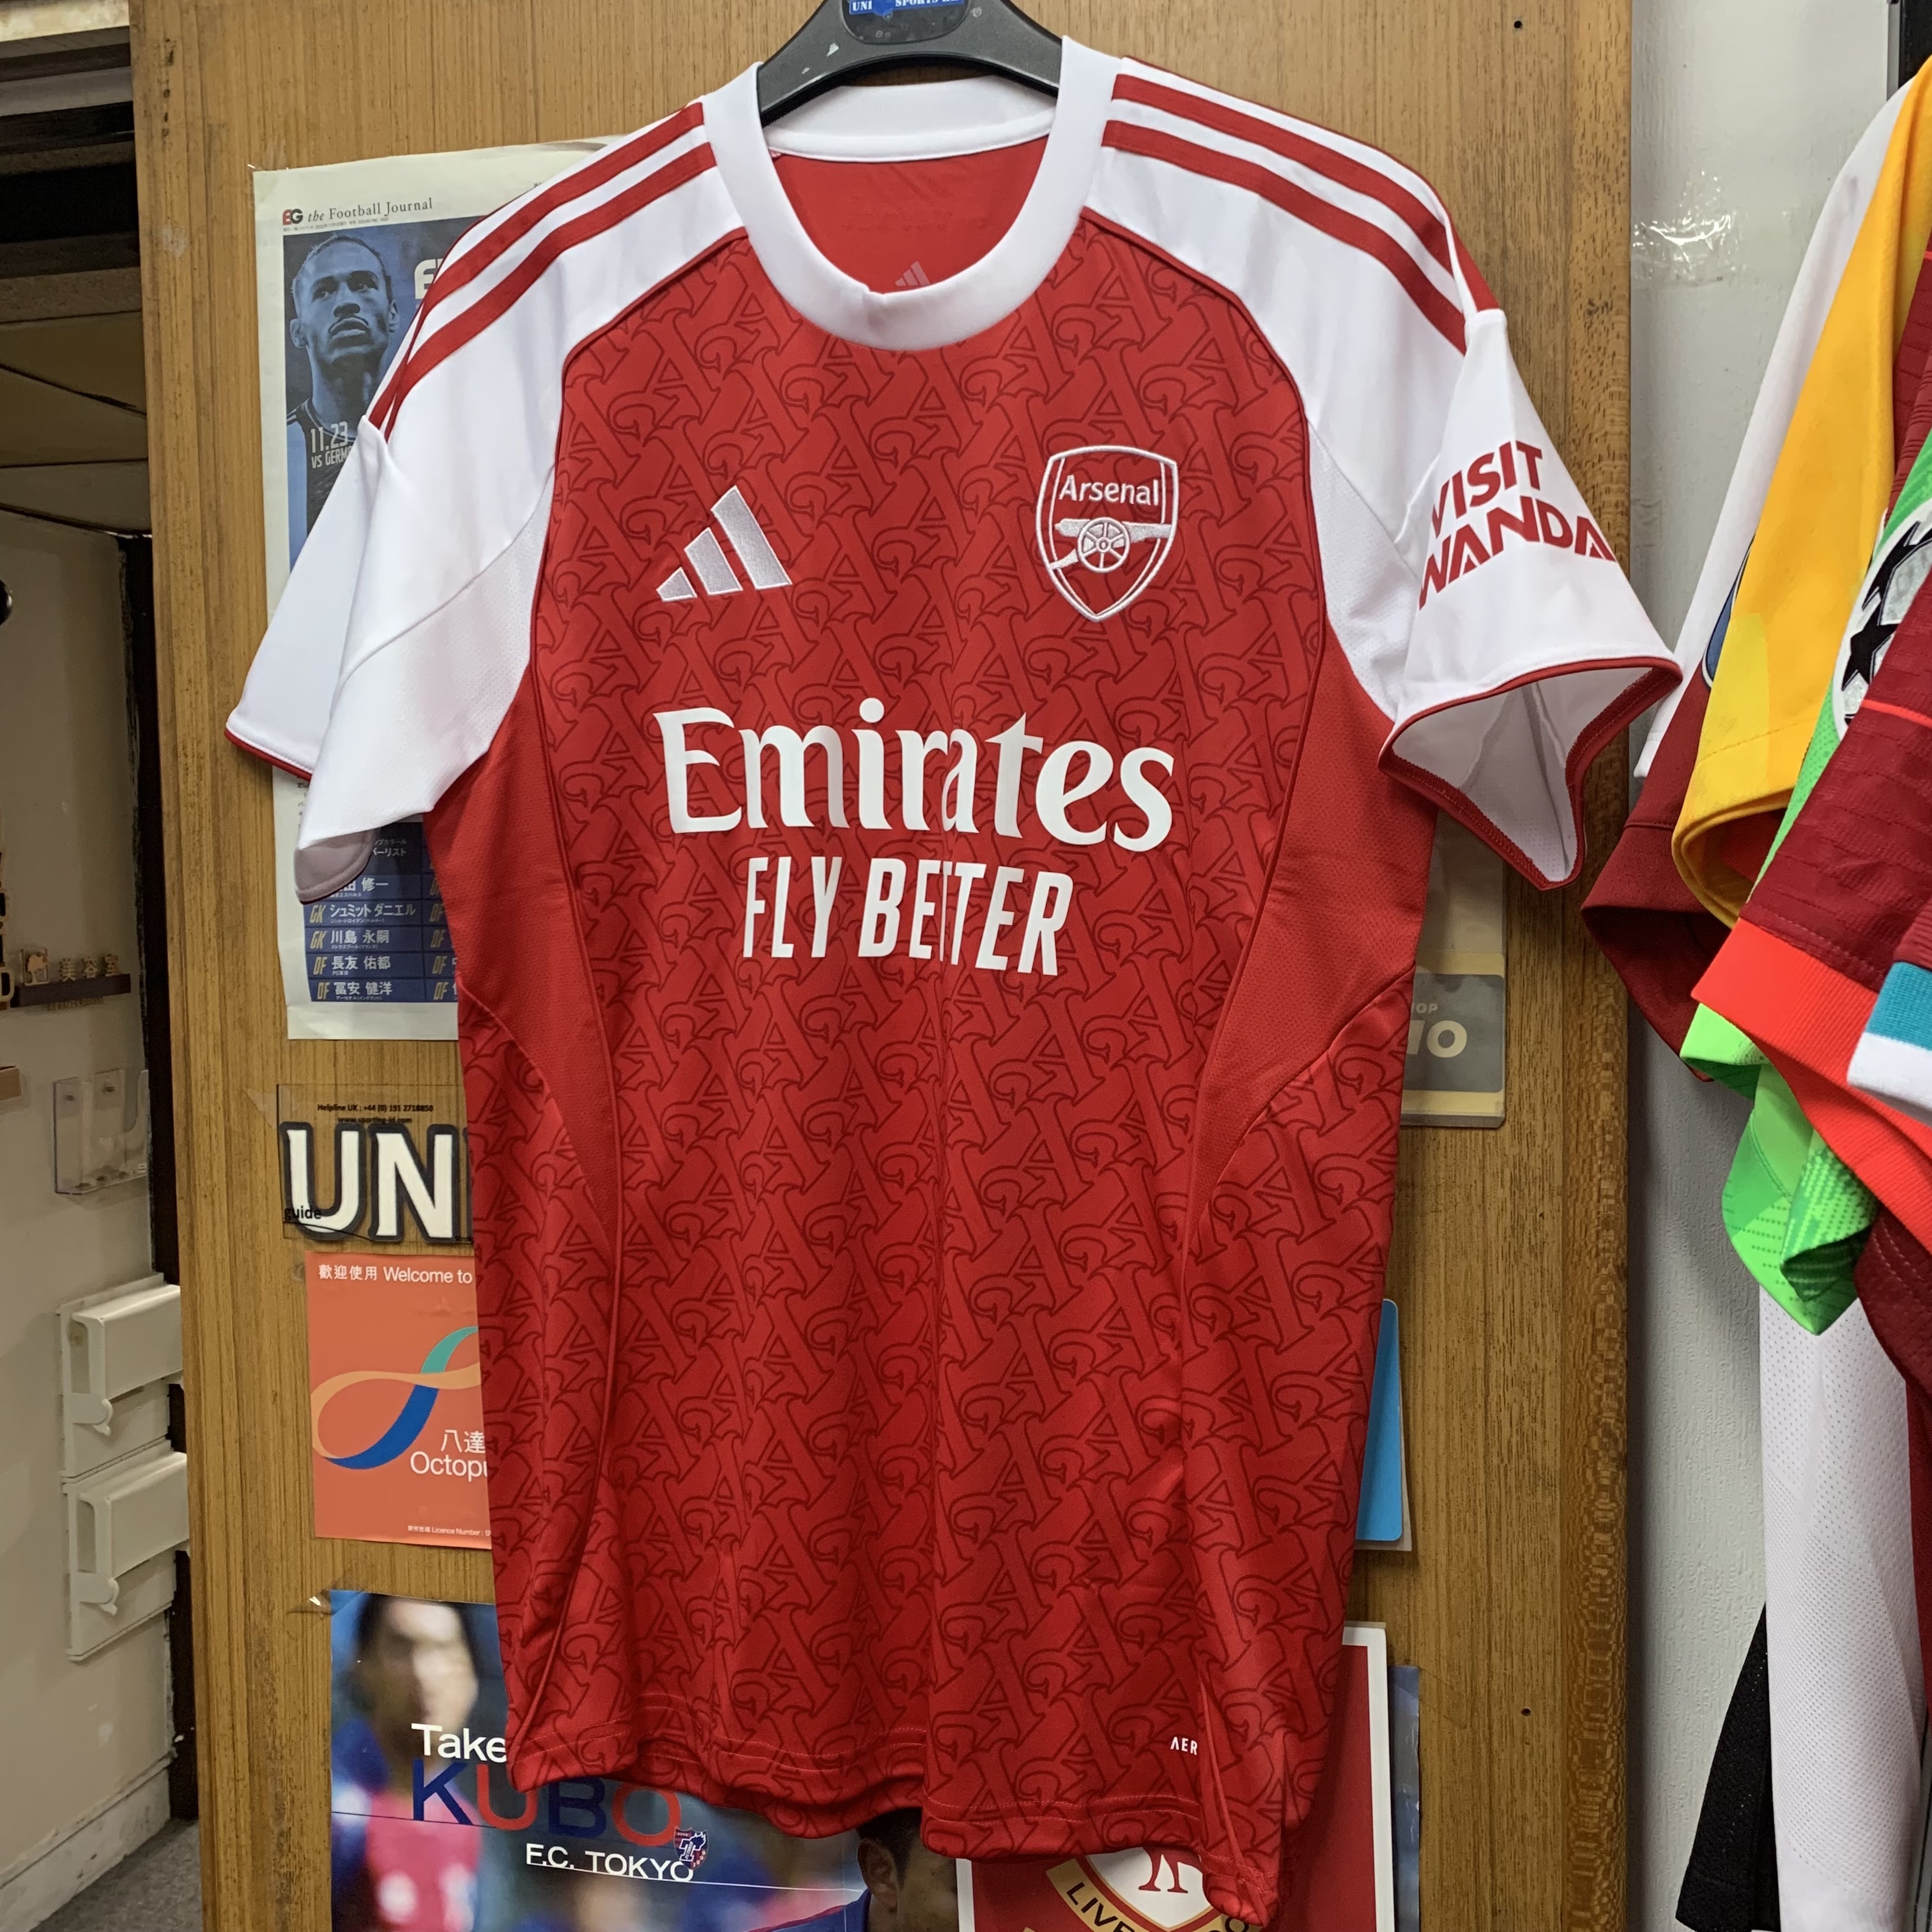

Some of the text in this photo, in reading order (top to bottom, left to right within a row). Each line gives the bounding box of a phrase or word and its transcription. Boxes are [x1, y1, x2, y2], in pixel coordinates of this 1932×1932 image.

[852, 1, 873, 11] UNI
[307, 210, 325, 222] the
[328, 202, 381, 219] Football
[384, 197, 433, 217] Journal
[310, 421, 348, 453] 11.23
[311, 454, 323, 468] VS
[1059, 474, 1160, 506] Arsenal
[1431, 440, 1543, 539] VISIT
[652, 697, 1175, 852] Emirates
[339, 877, 388, 892] 田 修一
[310, 903, 416, 924] GK シュミット ダニエル
[742, 855, 843, 958] FLY
[310, 930, 390, 949] GK 川島 永嗣
[431, 930, 446, 948] DF
[313, 955, 391, 975] DF 長友 佑都
[432, 955, 448, 975] DF
[317, 982, 330, 1000] DF
[365, 981, 393, 996] 健洋
[433, 981, 449, 1000] DF
[317, 1104, 346, 1112] Helpline
[378, 1104, 387, 1113] (0)
[280, 1122, 471, 1243] UN
[284, 1205, 322, 1221] guide
[318, 1264, 473, 1284] 歡迎使用 Welcome to
[431, 1526, 456, 1535] Licence
[456, 1528, 481, 1536] Number
[411, 1722, 507, 1763] Take
[412, 1758, 682, 1847] KUBO
[526, 1843, 574, 1869] F.C.
[585, 1850, 694, 1883] TOKYO
